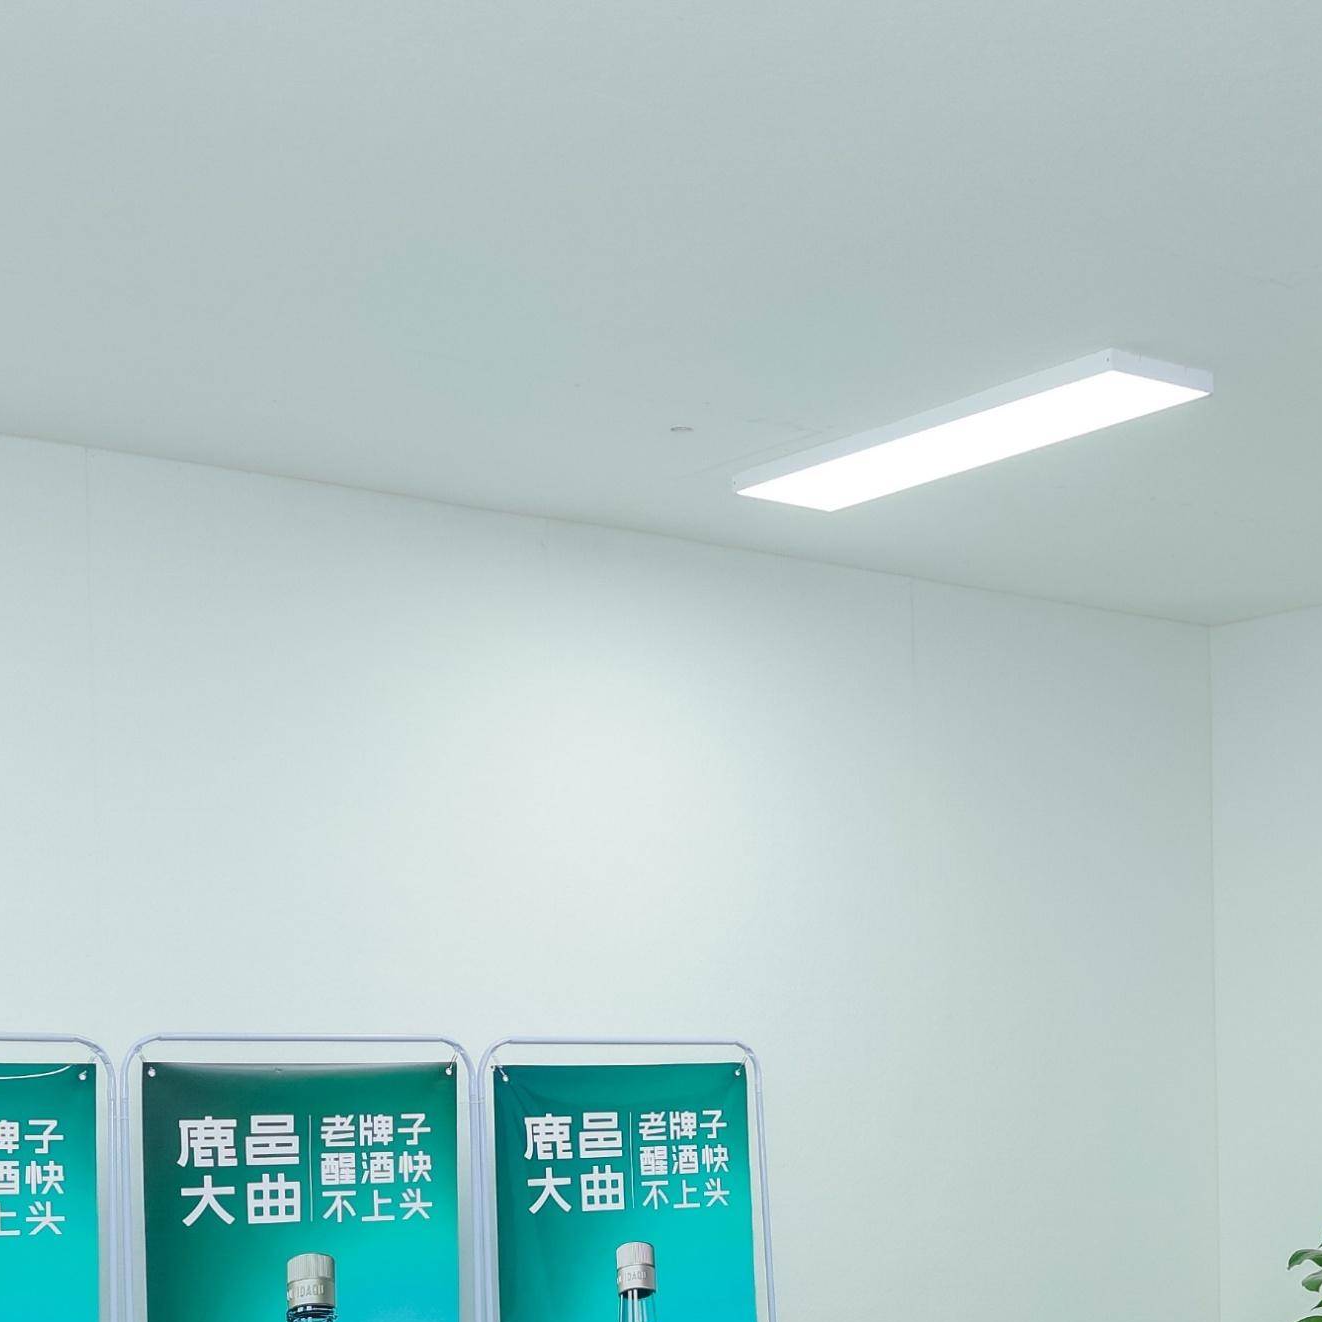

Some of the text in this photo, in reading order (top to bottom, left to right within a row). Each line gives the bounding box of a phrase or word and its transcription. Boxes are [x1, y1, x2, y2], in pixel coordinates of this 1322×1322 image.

[177, 1114, 301, 1167] 鹿邑
[320, 1113, 431, 1147] 老牌子
[524, 1112, 624, 1160] 鹿邑
[638, 1110, 727, 1141] 老牌子
[321, 1150, 432, 1185] 醒酒快
[639, 1144, 729, 1175] 醒酒快
[181, 1174, 301, 1226] 大曲
[322, 1188, 433, 1223] 不上头
[527, 1165, 625, 1214] 大曲
[641, 1178, 730, 1209] 不上头
